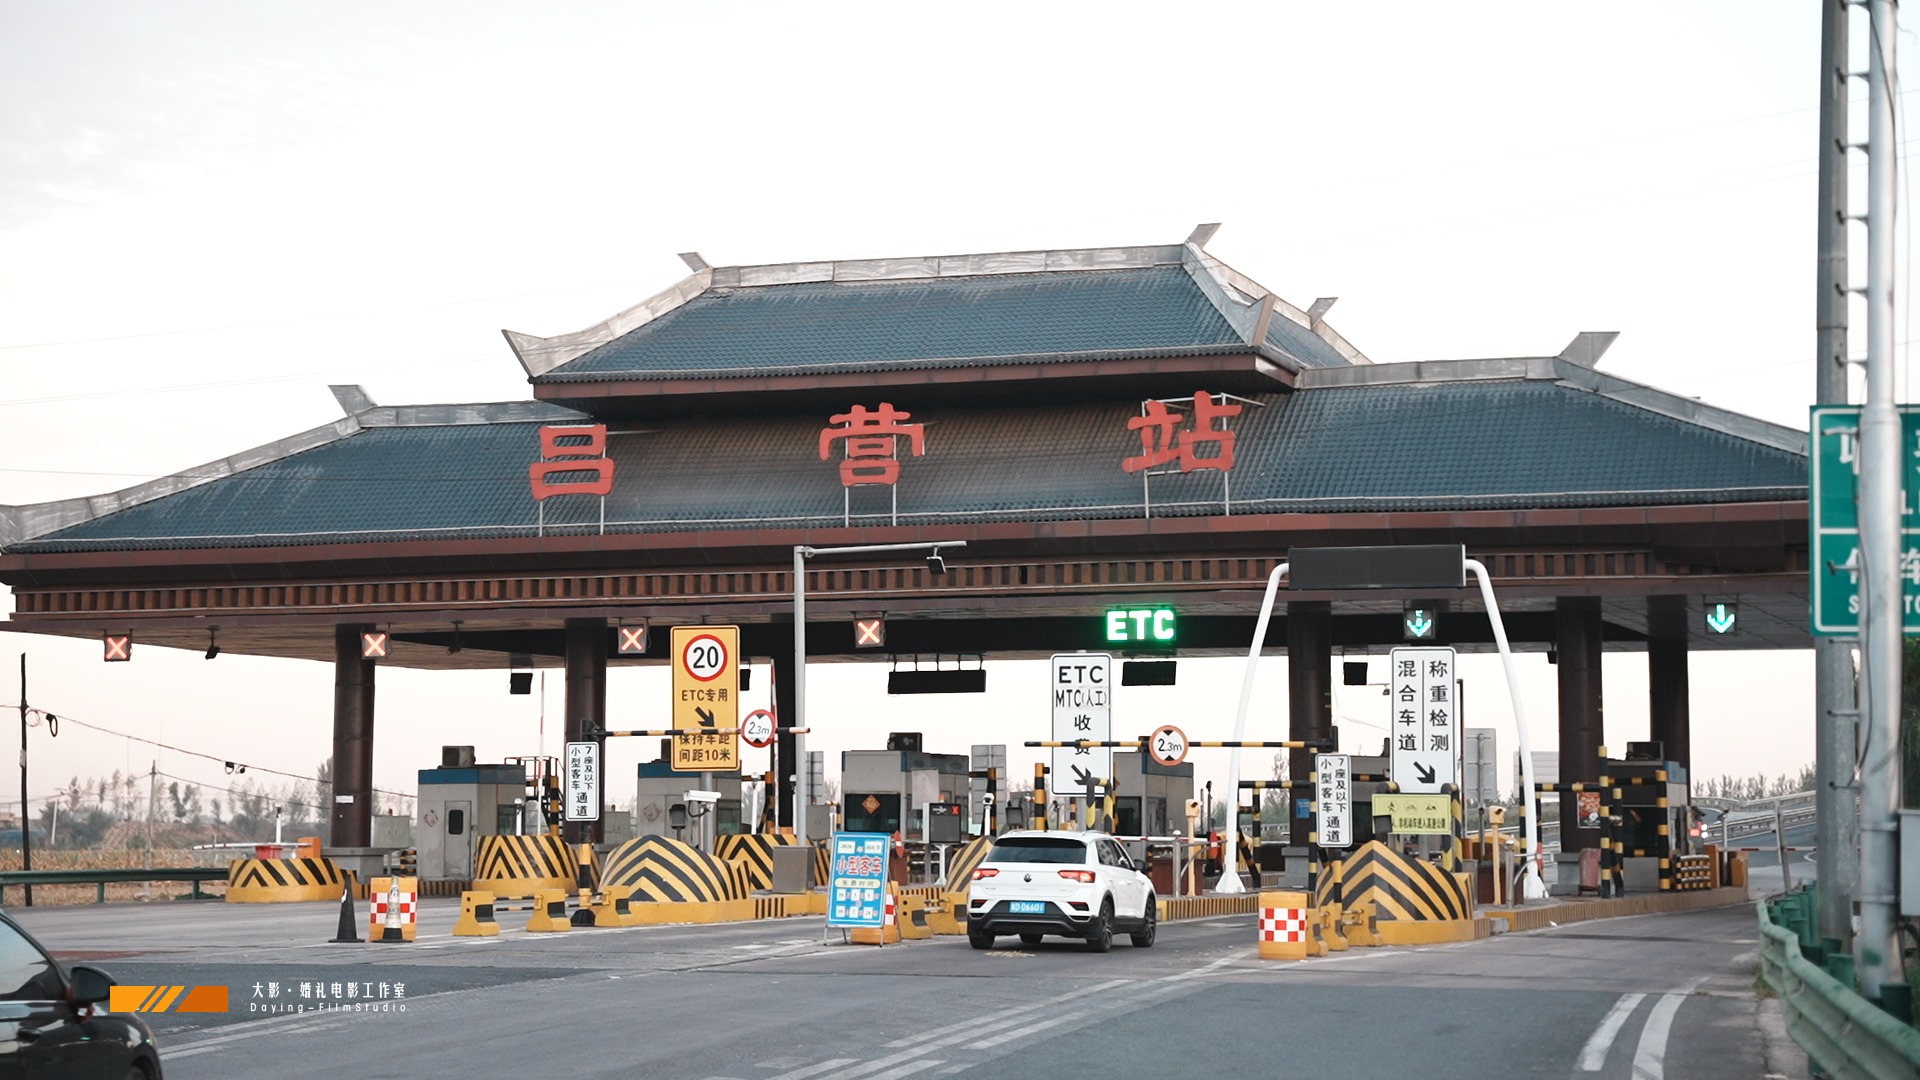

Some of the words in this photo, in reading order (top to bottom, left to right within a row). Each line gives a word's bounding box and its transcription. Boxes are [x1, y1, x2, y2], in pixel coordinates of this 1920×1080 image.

[530, 391, 1243, 499] 吕营站
[1106, 609, 1174, 641] ETC
[692, 646, 719, 669] 20
[1059, 666, 1103, 684] ETC
[681, 688, 728, 702] ETC专用
[1398, 660, 1417, 751] 混合车道
[1429, 660, 1449, 752] 称重检测
[571, 747, 581, 790] 小型客车
[584, 746, 594, 790] 7座及以下
[679, 748, 731, 762] 间距10米
[1320, 758, 1333, 813] 小型客车
[1335, 758, 1347, 813] 7座及以下
[576, 792, 588, 816] 通道
[1326, 816, 1341, 843] 通道
[836, 855, 882, 876] 小型客车
